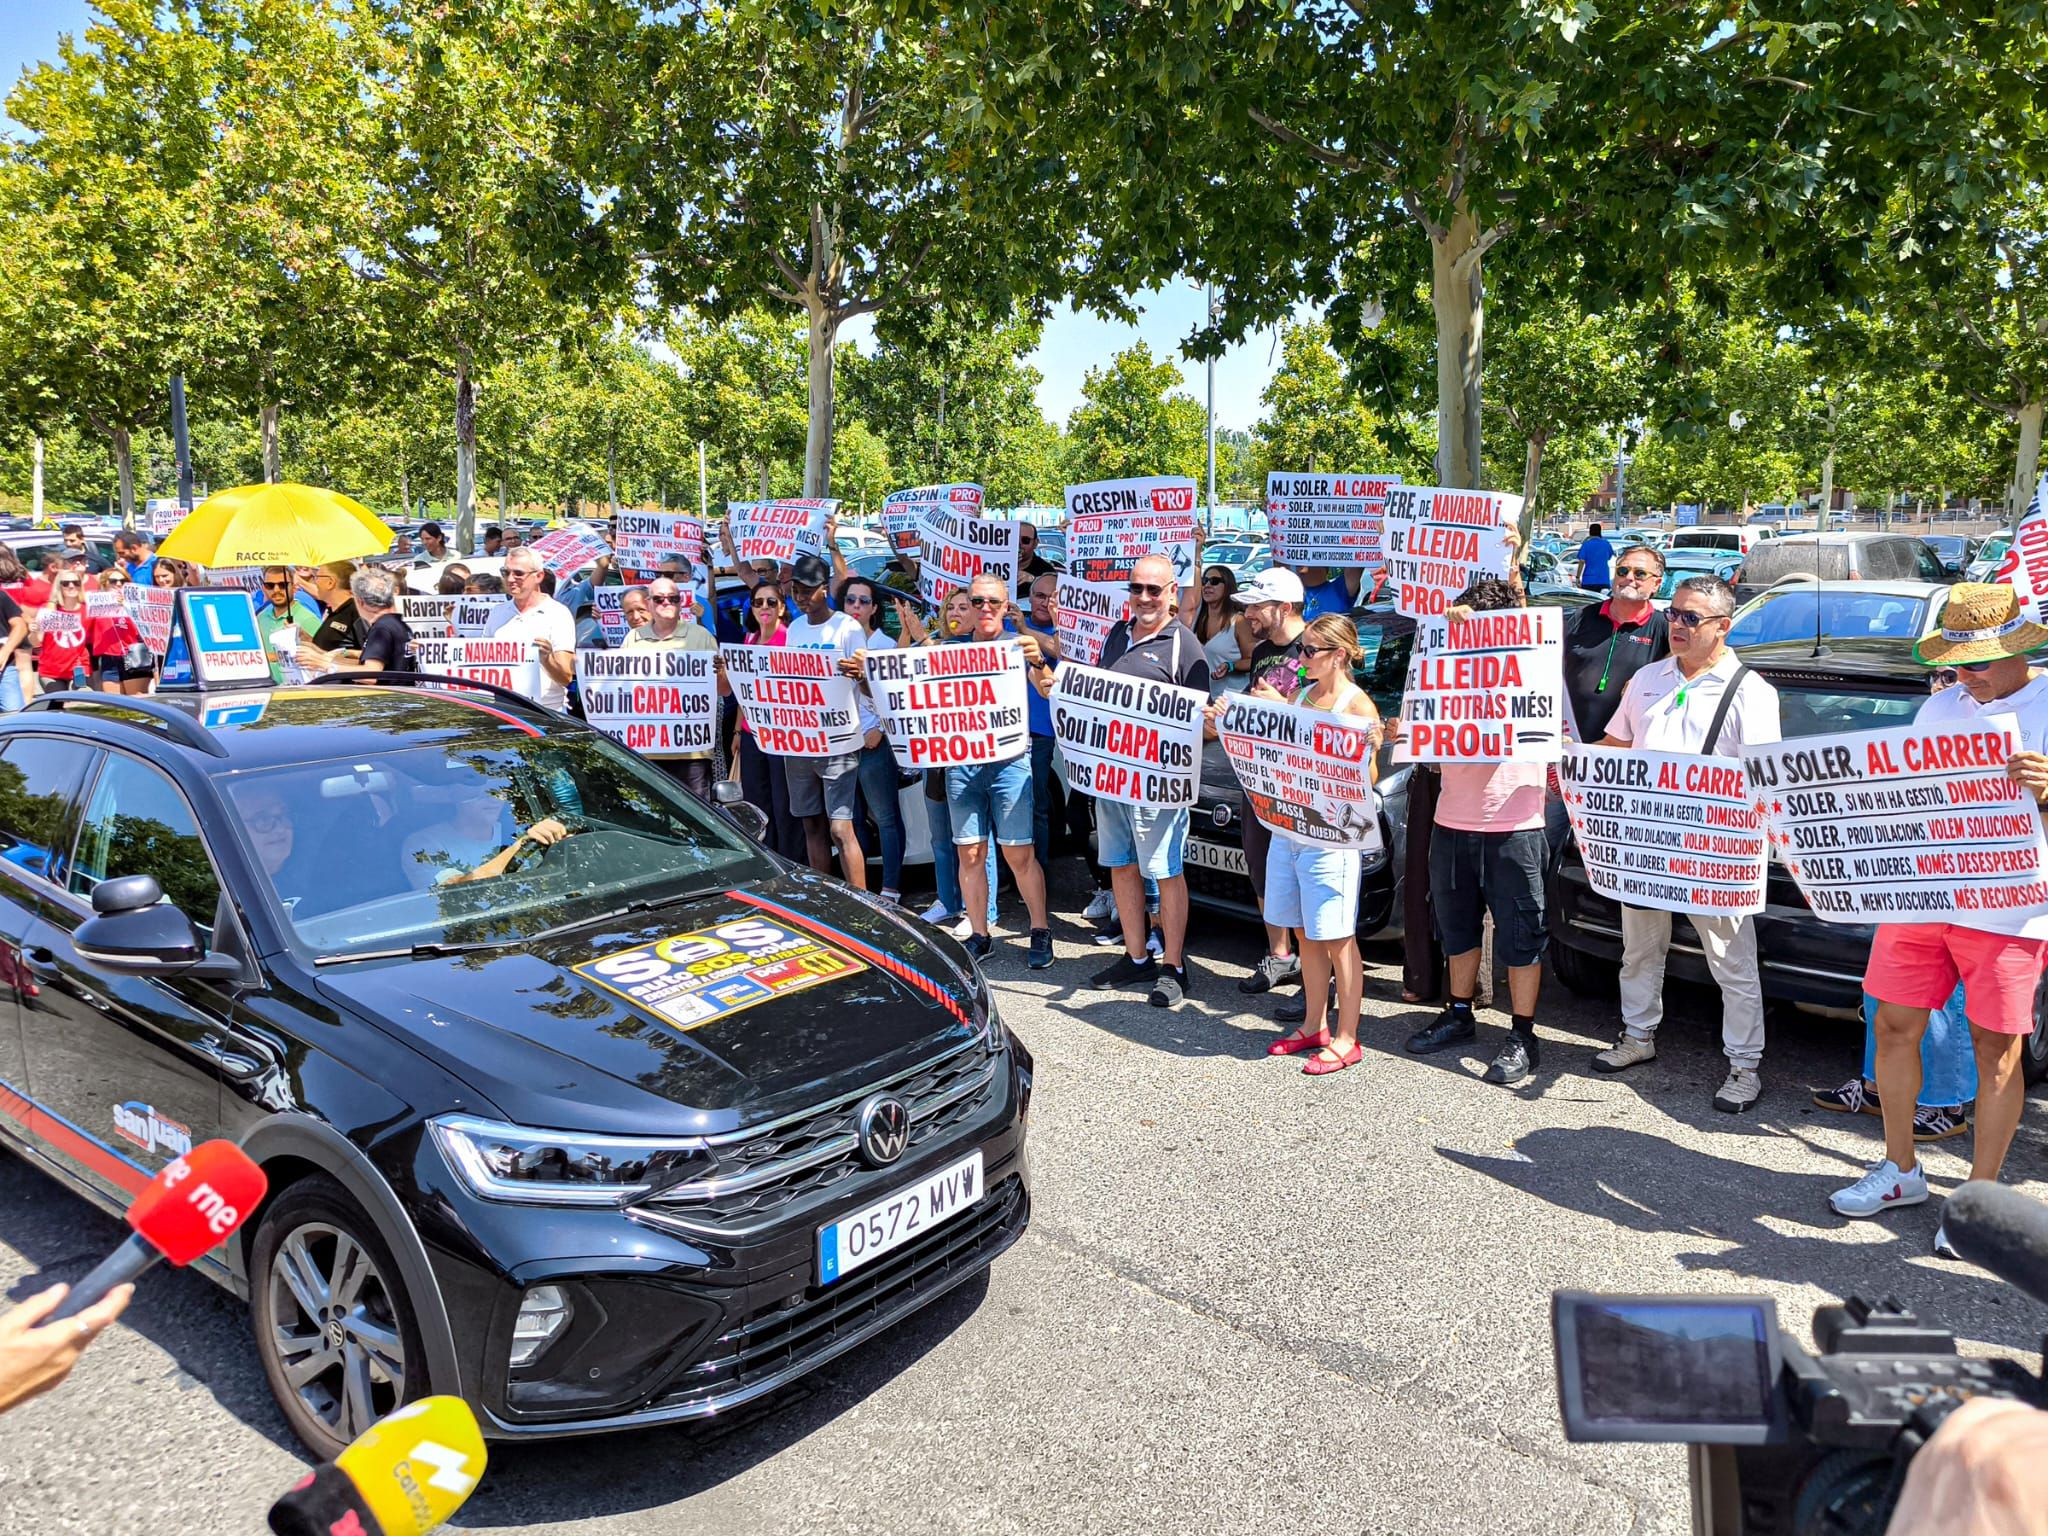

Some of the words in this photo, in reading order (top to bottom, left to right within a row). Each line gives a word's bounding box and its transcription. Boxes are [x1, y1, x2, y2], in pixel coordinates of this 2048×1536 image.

[888, 489, 939, 502] CRESPIN
[1072, 490, 1138, 514] CRESPIN
[1272, 480, 1290, 496] MJ
[1293, 480, 1331, 497] SOLER,
[1334, 480, 1348, 496] AL
[738, 509, 750, 520] DE
[750, 506, 810, 526] LLEIDA
[1288, 502, 1316, 514] SOLER,
[1384, 491, 1416, 524] PERE,
[1419, 499, 1432, 518] DE
[1431, 494, 1492, 526] NAVARRA
[758, 524, 796, 540] FOTRÀS
[796, 529, 820, 547] MÉS!
[960, 518, 964, 540] i
[969, 521, 1011, 546] Soler
[1077, 520, 1099, 531] PROU
[1132, 517, 1154, 528] VOLEM
[1078, 534, 1104, 544] DEIXEU
[1106, 534, 1114, 543] EL
[1144, 532, 1158, 542] FEU
[1160, 532, 1168, 541] LA
[1288, 518, 1312, 530] SOLER,
[1314, 520, 1326, 528] PROU
[1351, 520, 1366, 530] VOLEM
[742, 538, 796, 560] PROu!
[1078, 546, 1100, 557] PRO?
[1105, 546, 1120, 556] NO.
[1123, 544, 1152, 555] PROU!
[1287, 534, 1311, 545] SOLER,
[1391, 531, 1405, 552] DE
[1407, 527, 1479, 563] LLEIDA
[236, 552, 266, 561] RACC
[1287, 550, 1310, 561] SOLER,
[1396, 560, 1418, 582] TE'N
[1420, 560, 1466, 590] FOTRÀS
[1059, 584, 1110, 618] CRESPIN
[203, 604, 244, 643] L
[1430, 628, 1444, 648] DE
[1448, 614, 1532, 650] NAVARRA
[204, 652, 263, 666] PRACTICAS
[419, 643, 452, 664] PERE,
[452, 648, 462, 662] DE
[465, 642, 518, 662] NAVARRA
[584, 652, 651, 677] Navarro
[656, 652, 660, 675] i
[666, 652, 708, 677] Soler
[724, 649, 758, 677] PERE,
[759, 656, 770, 672] DE
[770, 651, 826, 677] NAVARRA
[866, 654, 914, 682] PERE,
[914, 658, 928, 675] DE
[928, 647, 1000, 676] NAVARRA
[1420, 654, 1522, 690] LLEIDA
[586, 688, 614, 714] Sou
[618, 686, 710, 718] inCAPAços
[740, 683, 754, 700] DE
[755, 679, 826, 706] LLEIDA
[888, 692, 906, 711] DE
[908, 679, 997, 710] LLEIDA
[1060, 666, 1134, 708] Navarro
[1136, 683, 1146, 711] i
[1148, 685, 1196, 723] Soler
[1440, 690, 1507, 720] FOTRÀS
[1512, 691, 1553, 718] MÉS!
[773, 707, 818, 728] FOTRÀS
[820, 708, 850, 728] MÉS!
[931, 708, 988, 734] FOTRÀS
[990, 706, 1022, 729] MÉS!
[1222, 704, 1297, 744] CRESPIN
[627, 724, 655, 749] CAP
[660, 724, 670, 748] A
[674, 724, 712, 747] CASA
[758, 726, 829, 752] PROu!
[909, 733, 996, 764] PROu!
[1056, 708, 1088, 744] Sou
[1090, 717, 1193, 770] inCAPAços
[1411, 724, 1513, 756] PROu!
[1227, 739, 1250, 756] PROU
[1286, 754, 1312, 770] VOLEM
[1745, 755, 1778, 788] MJ
[1782, 746, 1863, 784] SOLER,
[1867, 741, 1900, 775] AL
[1903, 731, 2012, 772] CARRER!
[1095, 762, 1128, 796] CAP
[1130, 771, 1142, 800] A
[1146, 774, 1193, 803] CASA
[1260, 766, 1270, 778] EL
[1305, 777, 1320, 791] FEU
[1322, 783, 1333, 794] LA
[1336, 786, 1366, 801] FEINA!
[1562, 756, 1588, 782] MJ
[1593, 758, 1652, 789] SOLER,
[1657, 762, 1680, 790] AL
[1262, 781, 1280, 796] NO.
[1282, 786, 1314, 806] PROU!
[1586, 792, 1626, 816] SOLER,
[1631, 799, 1639, 814] SI
[1641, 800, 1652, 816] NO
[1654, 802, 1662, 817] HI
[1664, 803, 1674, 819] HA
[1676, 804, 1704, 824] GESTIÓ,
[1787, 791, 1844, 817] SOLER,
[1847, 794, 1858, 812] SI
[1859, 792, 1874, 811] NO
[1875, 792, 1888, 810] HI
[1890, 790, 1906, 808] HA
[1908, 784, 1948, 807] GESTIÓ,
[1276, 801, 1308, 820] PASSA.
[1296, 820, 1308, 834] ES
[1586, 818, 1622, 840] SOLER,
[1625, 826, 1643, 842] PROU
[1644, 828, 1682, 849] DILACIONS,
[1684, 832, 1710, 851] VOLEM
[1712, 835, 1763, 856] SOLUCIONS!
[1794, 825, 1846, 850] SOLER,
[1847, 827, 1873, 846] PROU
[1875, 822, 1929, 844] DILACIONS,
[1927, 816, 1966, 840] VOLEM
[1968, 812, 2034, 838] SOLUCIONS!
[1588, 843, 1620, 866] SOLER,
[1624, 852, 1634, 866] NO
[1636, 853, 1668, 874] LIDERES,
[1670, 854, 1698, 877] NOMÉS
[1700, 862, 1761, 880] DESESPERES!
[1802, 859, 1852, 881] SOLER,
[1854, 860, 1870, 878] NO
[1871, 856, 1916, 877] LIDERES,
[1916, 849, 1956, 875] NOMÉS
[1956, 847, 2040, 874] DESESPERES!
[1624, 878, 1646, 896] MENYS
[1648, 883, 1690, 904] DISCURSOS,
[1692, 885, 1710, 904] MÉS
[1712, 889, 1760, 908] RECURSOS!
[1862, 891, 1894, 912] MENYS
[1895, 890, 1955, 912] DISCURSOS,
[1954, 884, 1978, 910] MÉS
[188, 1183, 239, 1235] rne
[850, 1195, 920, 1256] 0572
[827, 1257, 834, 1270] E
